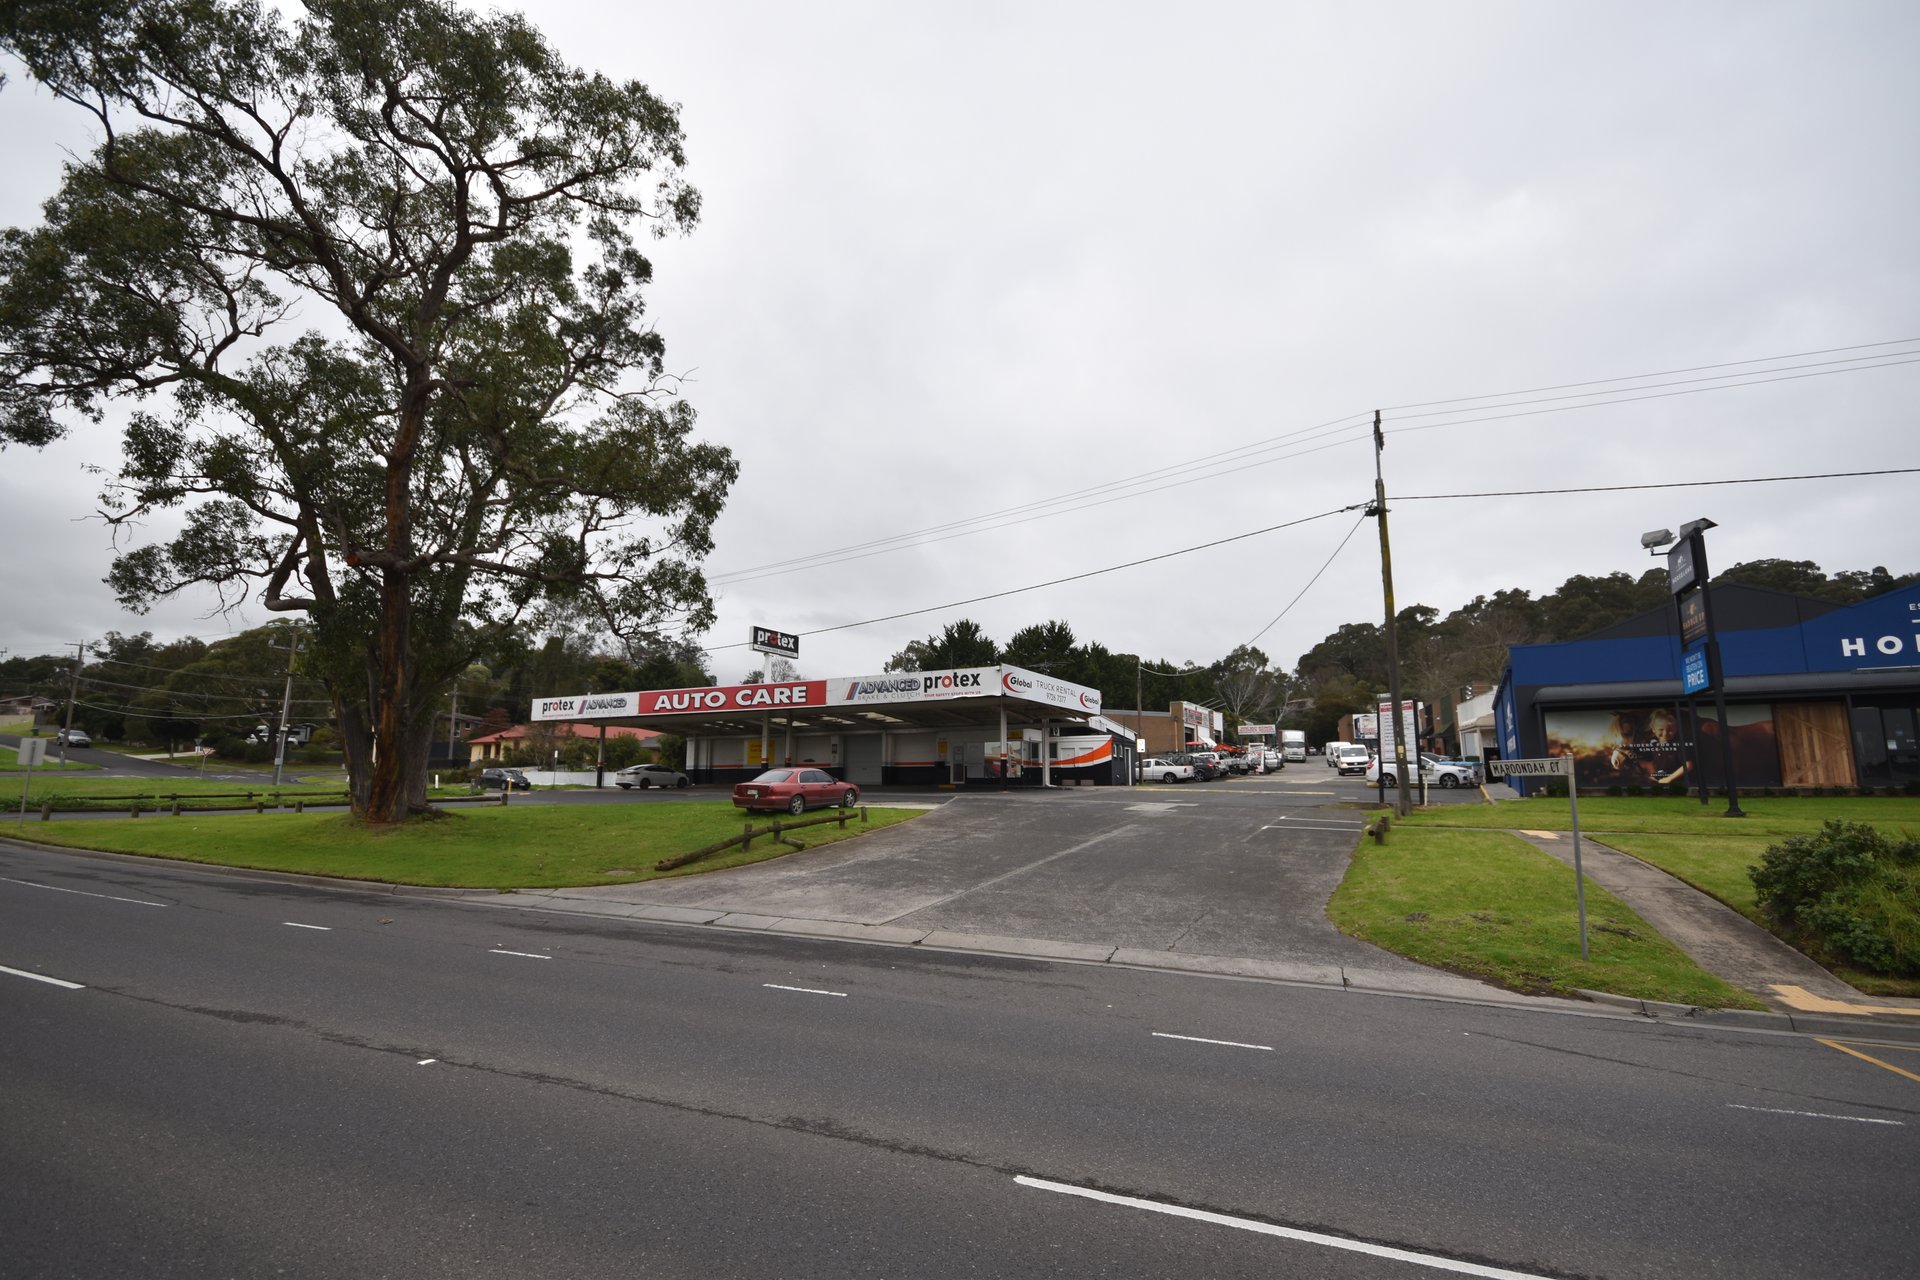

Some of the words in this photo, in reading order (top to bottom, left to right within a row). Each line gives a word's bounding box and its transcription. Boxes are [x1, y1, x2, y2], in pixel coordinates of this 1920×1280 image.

[757, 630, 795, 650] protex
[1841, 634, 1920, 656] HO
[923, 672, 981, 693] protex
[1010, 676, 1033, 689] Global
[1687, 669, 1705, 688] PRICE
[858, 679, 921, 694] ADVANCED
[1036, 680, 1055, 692] TRUCK
[1056, 685, 1077, 698] RENTAL
[586, 697, 627, 710] ADVANCED
[653, 691, 727, 711] AUTO
[735, 686, 807, 706] CARE
[858, 693, 880, 701] BRAKE
[892, 691, 921, 699] CLUTCH
[1084, 695, 1099, 705] Global
[542, 699, 575, 714] protex
[1492, 762, 1546, 775] MAROONDAH
[1549, 761, 1560, 773] CT
